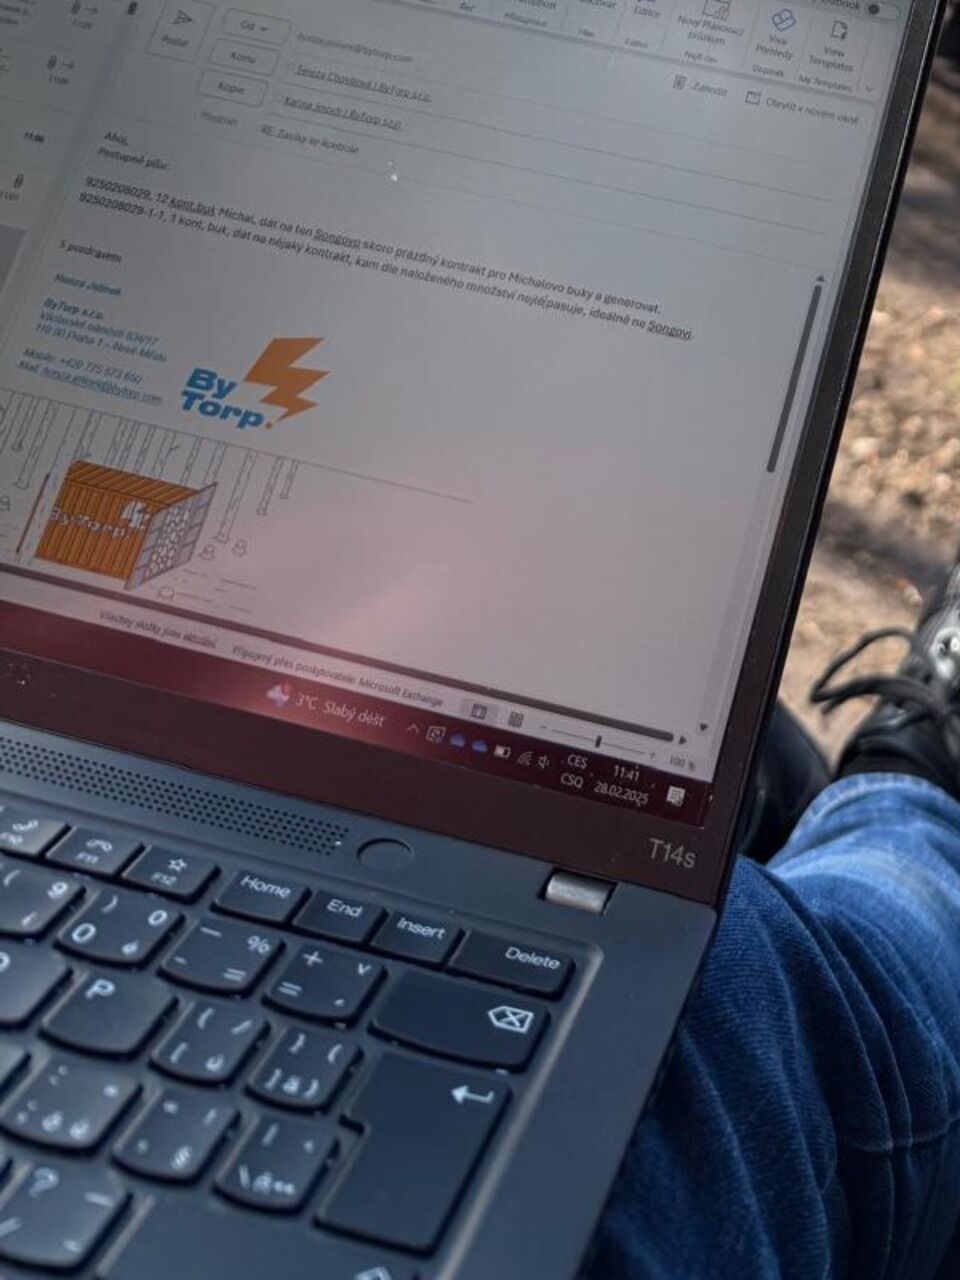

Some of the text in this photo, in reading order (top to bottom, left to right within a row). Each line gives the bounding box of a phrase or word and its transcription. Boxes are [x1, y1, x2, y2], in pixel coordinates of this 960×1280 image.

[155, 193, 169, 202] 12
[279, 223, 293, 231] na
[295, 224, 313, 235] ten
[363, 240, 395, 254] skoro
[440, 257, 487, 275] kontrakt
[487, 268, 506, 279] pro
[566, 286, 593, 299] buky
[380, 261, 400, 273] dle
[185, 367, 237, 398] By
[358, 676, 402, 695] Microsoft
[321, 701, 357, 722] Slabý
[566, 754, 588, 767] CES
[648, 837, 696, 869] T14s
[241, 875, 291, 899] Home
[326, 898, 364, 918] End
[396, 916, 447, 940] Insert
[504, 946, 561, 970] Delete
[85, 978, 115, 999] P
